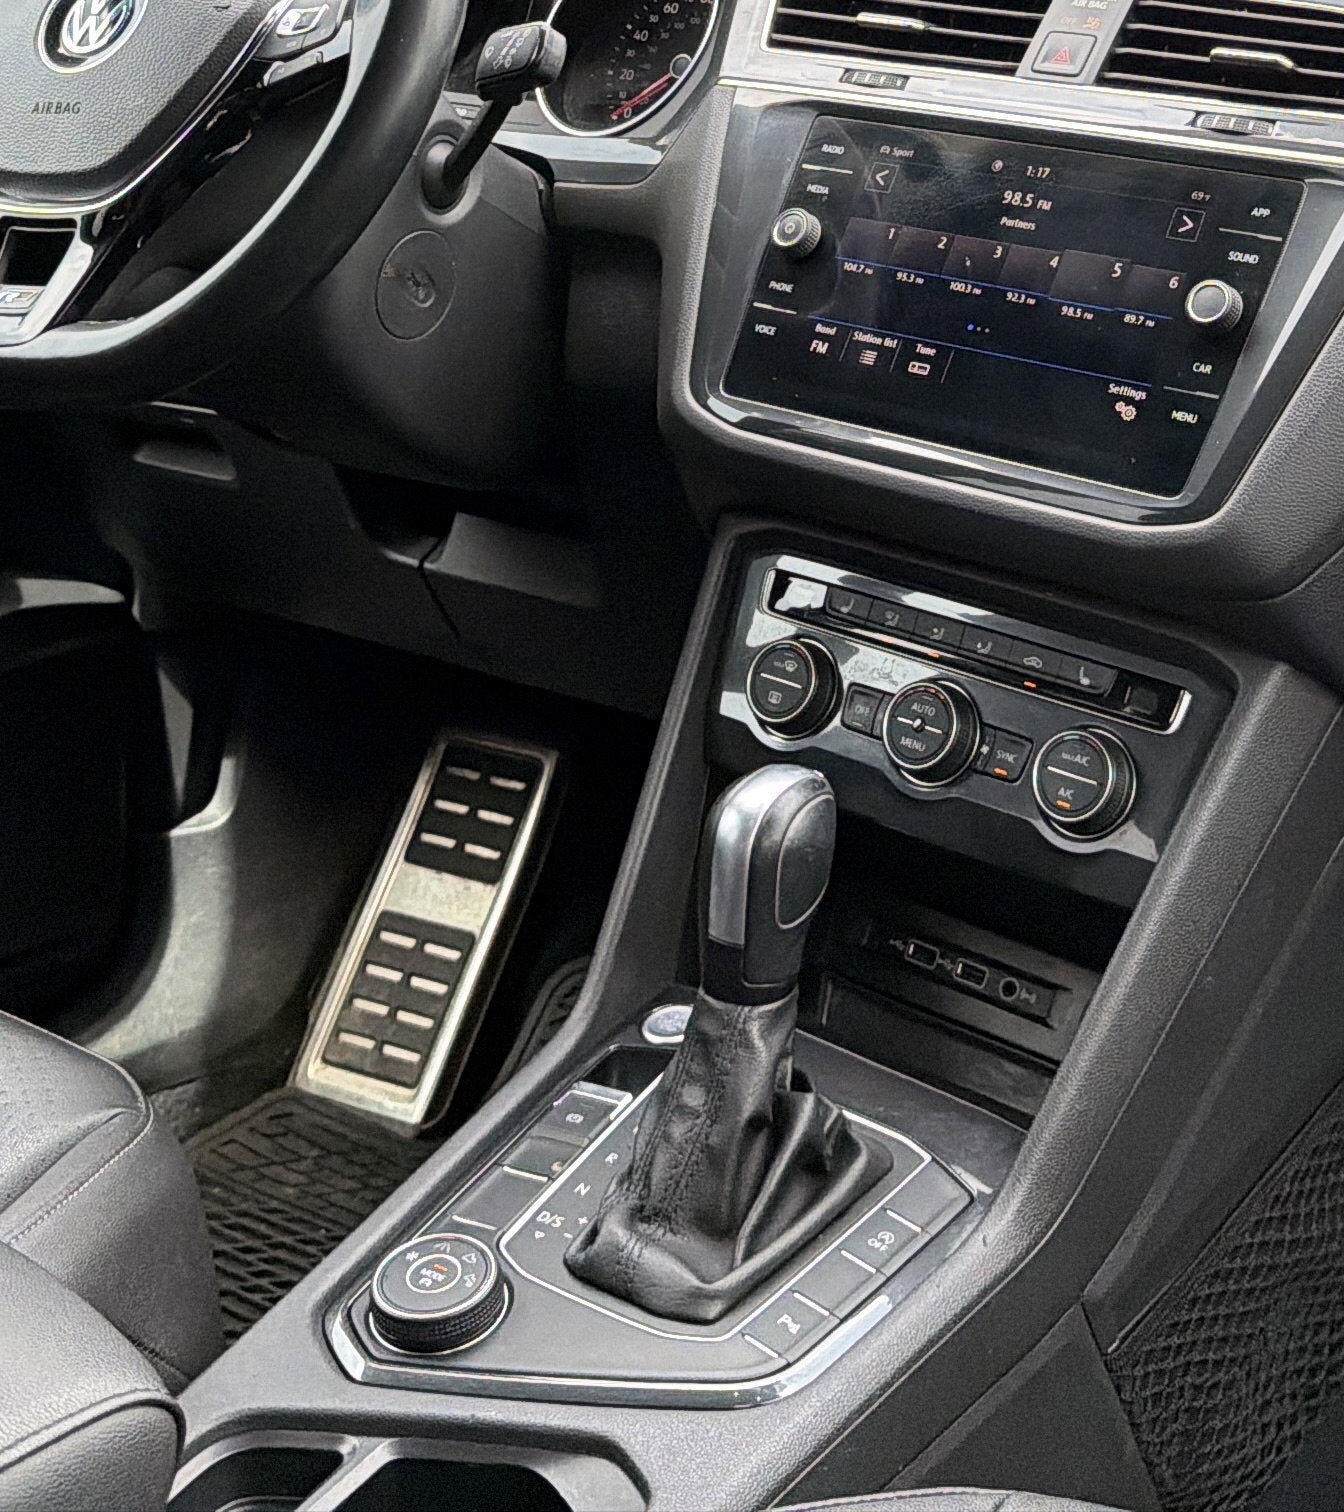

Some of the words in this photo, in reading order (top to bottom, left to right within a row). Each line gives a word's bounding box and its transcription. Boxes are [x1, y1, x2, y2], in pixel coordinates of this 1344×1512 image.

[663, 3, 679, 14] 60
[1071, 0, 1087, 8] AIR
[1087, 0, 1108, 10] BAG
[633, 30, 649, 42] 40
[619, 69, 634, 80] 20
[31, 102, 82, 115] AIRBAG
[623, 107, 632, 118] 0
[821, 144, 845, 155] RADIO
[892, 146, 915, 158] Sport
[1026, 165, 1051, 179] 1:17
[1001, 190, 1035, 208] 98.5
[1037, 199, 1052, 211] FM
[1251, 207, 1270, 218] APP
[1000, 216, 1037, 231] Partners
[888, 227, 896, 239] 1
[937, 236, 948, 249] 2
[992, 245, 1003, 258] 3
[1228, 251, 1260, 265] SOUND
[1049, 255, 1060, 268] 4
[1111, 262, 1123, 278] 5
[768, 280, 795, 293] PHONE
[1168, 276, 1180, 289] 6
[1006, 291, 1025, 304] 92.3
[1060, 306, 1082, 319] 98.5
[1123, 313, 1144, 325] 89.7
[754, 324, 777, 336] VOICE
[815, 323, 837, 336] Band
[853, 331, 882, 346] Station
[884, 337, 898, 349] list
[809, 339, 830, 355] FM
[915, 343, 937, 357] Tune
[1192, 362, 1213, 374] CAR
[1108, 383, 1148, 401] Settings
[1171, 409, 1199, 424] MENU
[910, 702, 936, 717] AUTO
[899, 736, 926, 752] MENU
[996, 749, 1017, 764] SYNC
[604, 1152, 619, 1164] R
[573, 1183, 592, 1196] N
[536, 1210, 564, 1228] D/S
[419, 1267, 447, 1282] MODE
